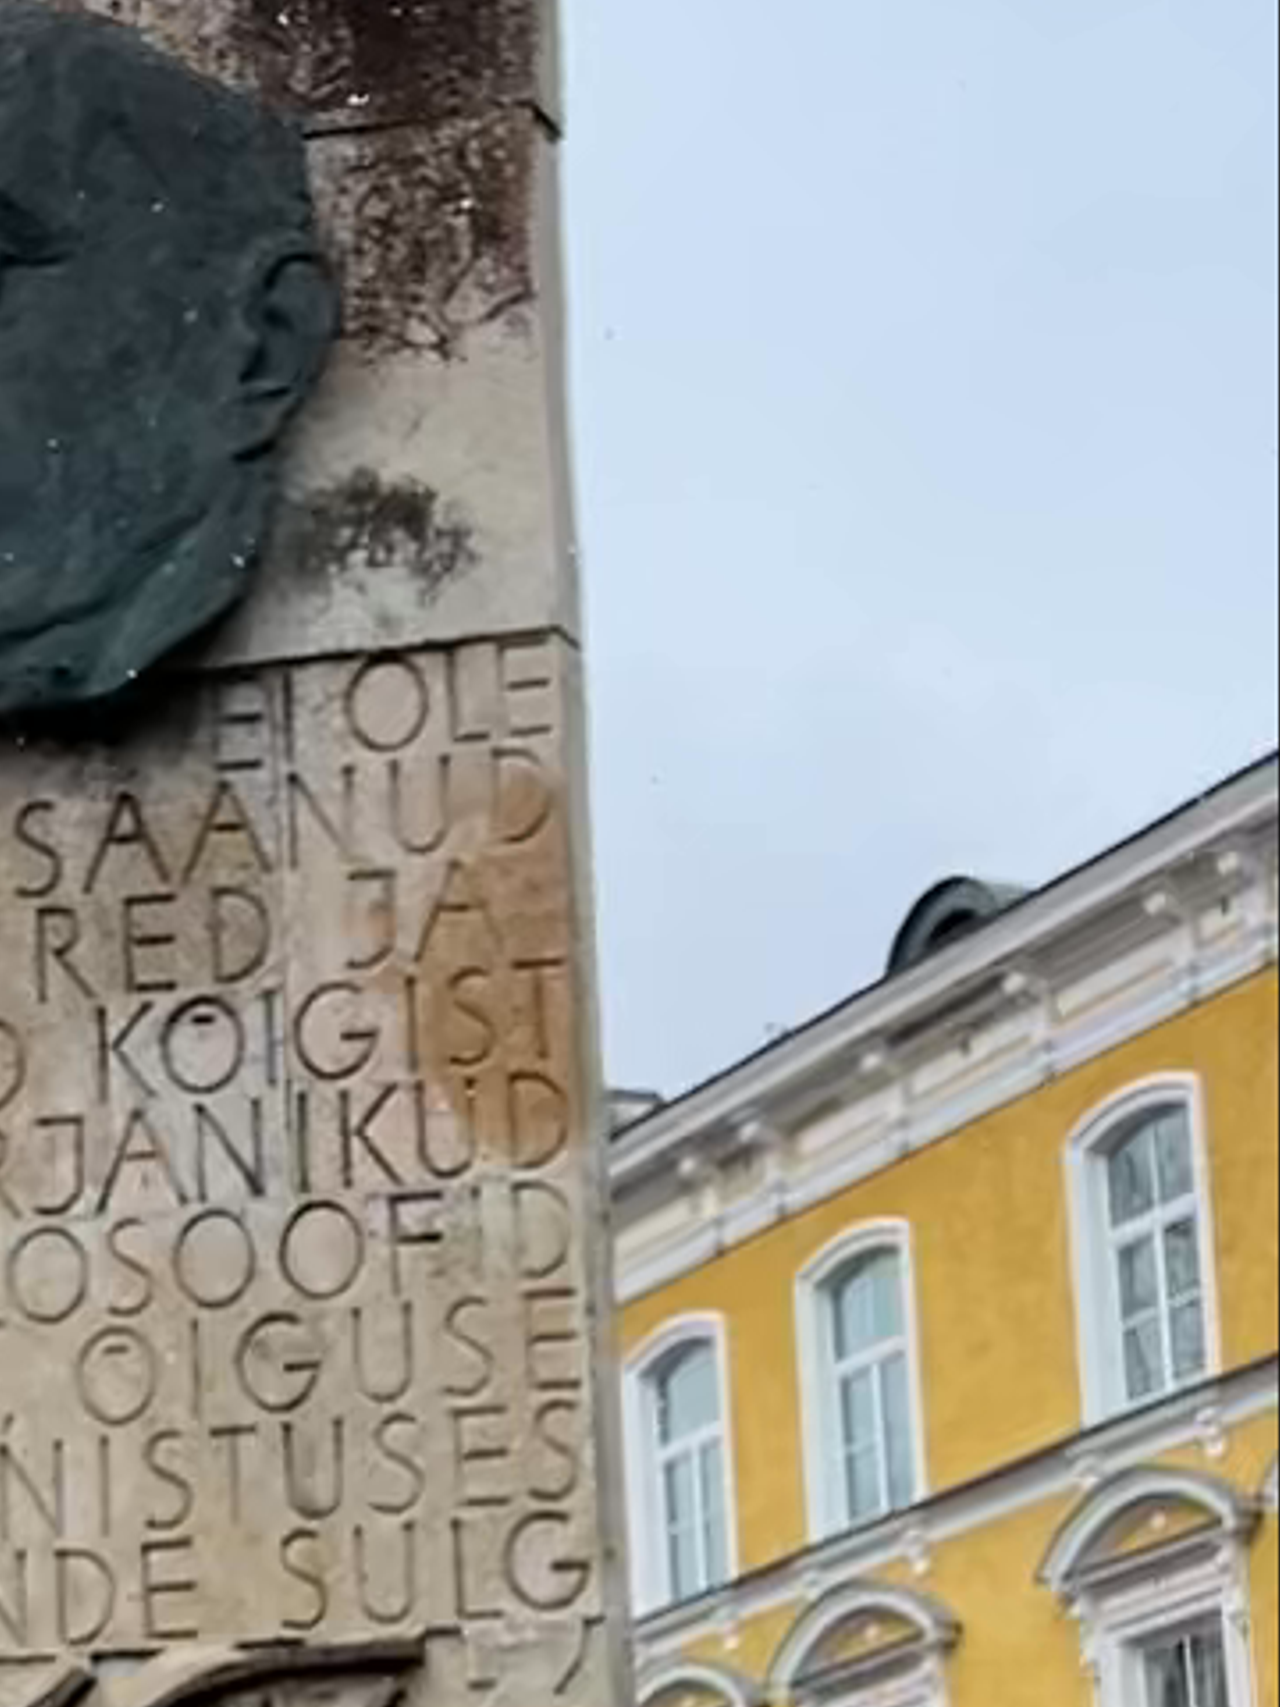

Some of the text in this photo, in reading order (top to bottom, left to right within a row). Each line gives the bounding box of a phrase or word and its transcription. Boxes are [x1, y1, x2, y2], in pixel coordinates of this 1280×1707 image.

[214, 667, 292, 775] EI
[344, 638, 552, 753] OLE
[14, 746, 553, 899] SAANUD
[346, 857, 502, 970] JA
[95, 958, 564, 1105] KÕIGIST
[77, 1289, 582, 1426] ÕIGUSE
[278, 1506, 592, 1631] SULG
